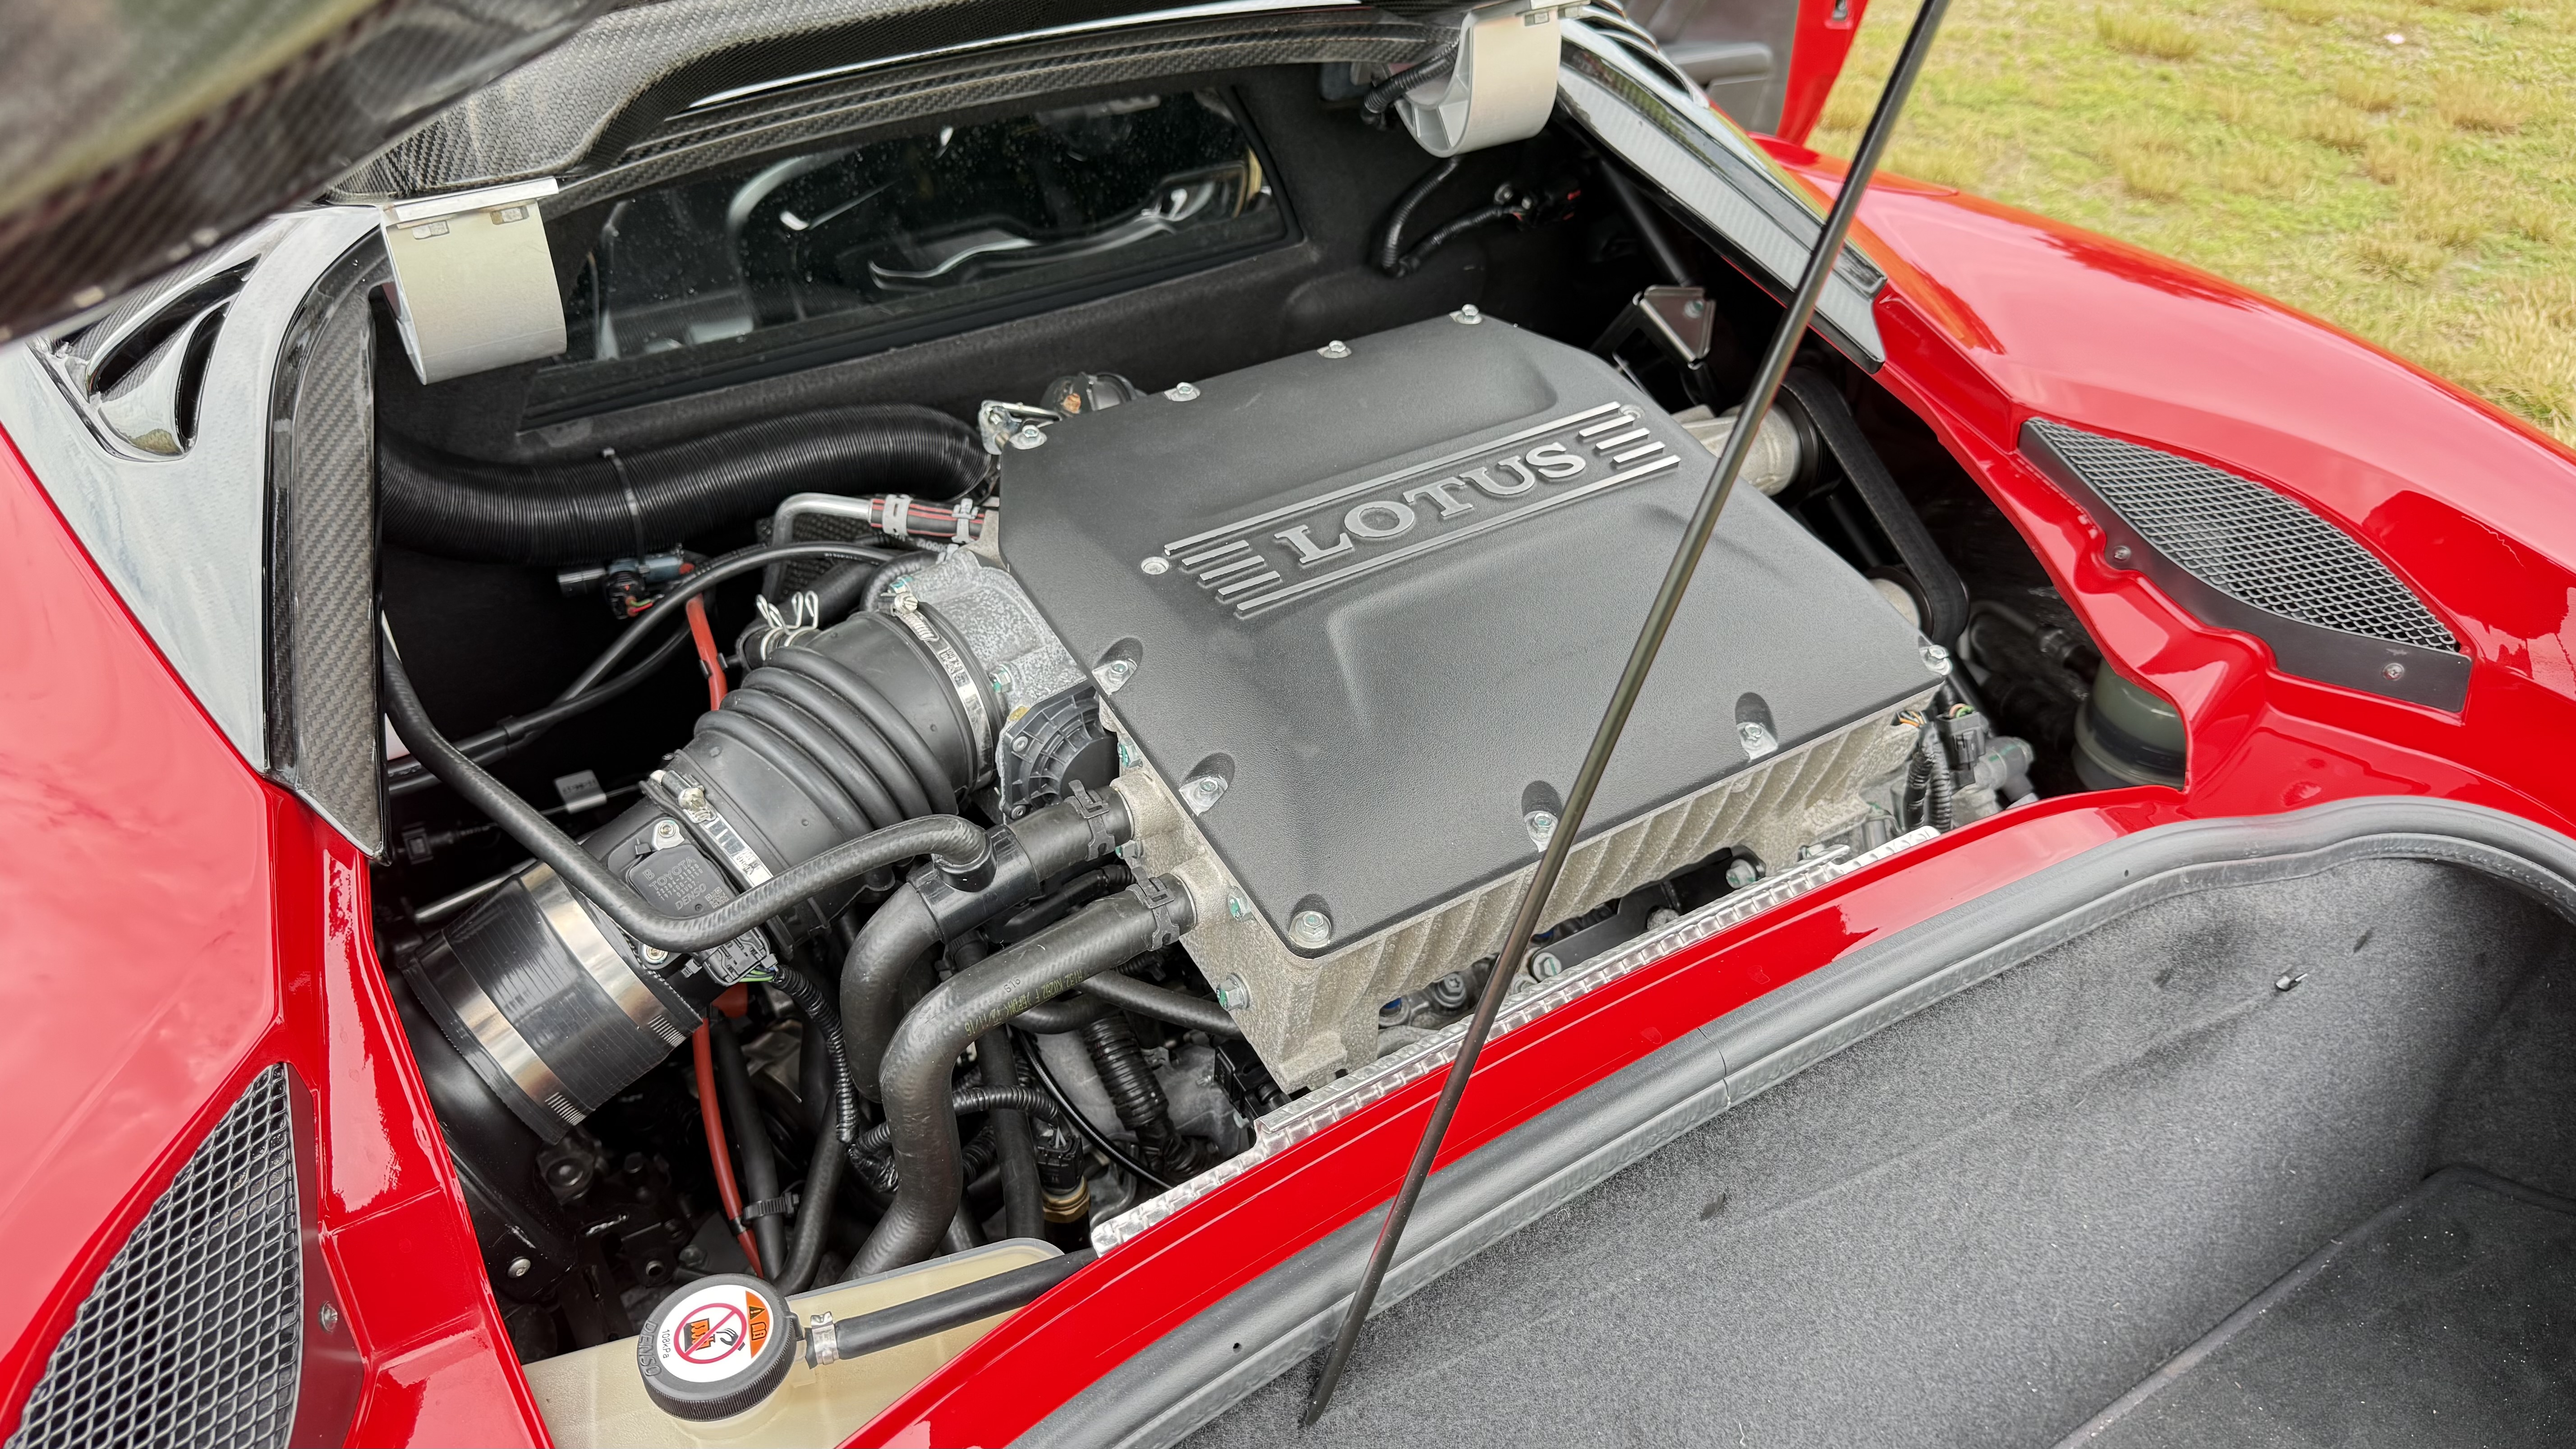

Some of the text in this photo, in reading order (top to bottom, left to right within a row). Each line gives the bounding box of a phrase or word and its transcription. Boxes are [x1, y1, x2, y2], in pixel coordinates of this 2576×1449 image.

[1274, 442, 1586, 565] LOTUS
[643, 869, 655, 880] B
[649, 857, 697, 891] TOYOTA
[657, 864, 699, 897] 22204-31020
[675, 883, 707, 910] DENSO
[638, 1320, 662, 1377] DENSO
[662, 1329, 671, 1359] 108kPa
